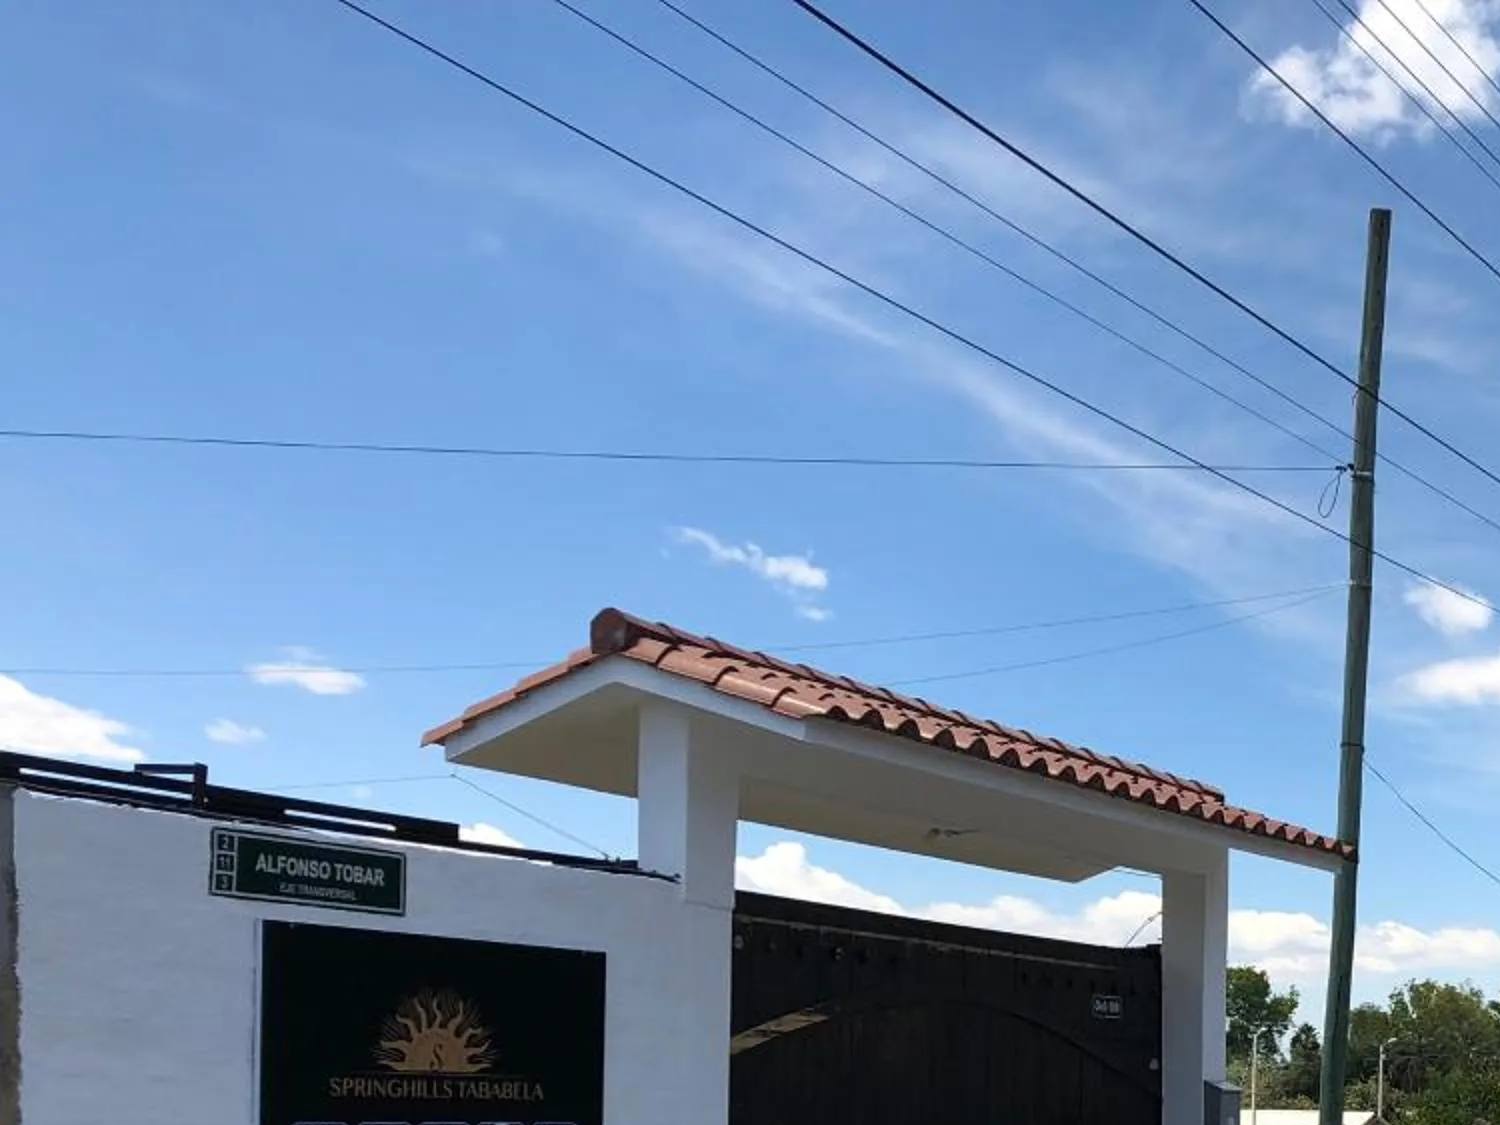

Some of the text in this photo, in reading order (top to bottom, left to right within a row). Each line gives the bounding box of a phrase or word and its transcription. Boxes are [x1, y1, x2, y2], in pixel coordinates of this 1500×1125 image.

[220, 836, 229, 849] 2
[255, 852, 385, 887] ALFONSO TOBAR
[328, 1075, 545, 1101] SPRINGHILLS TABABELA
